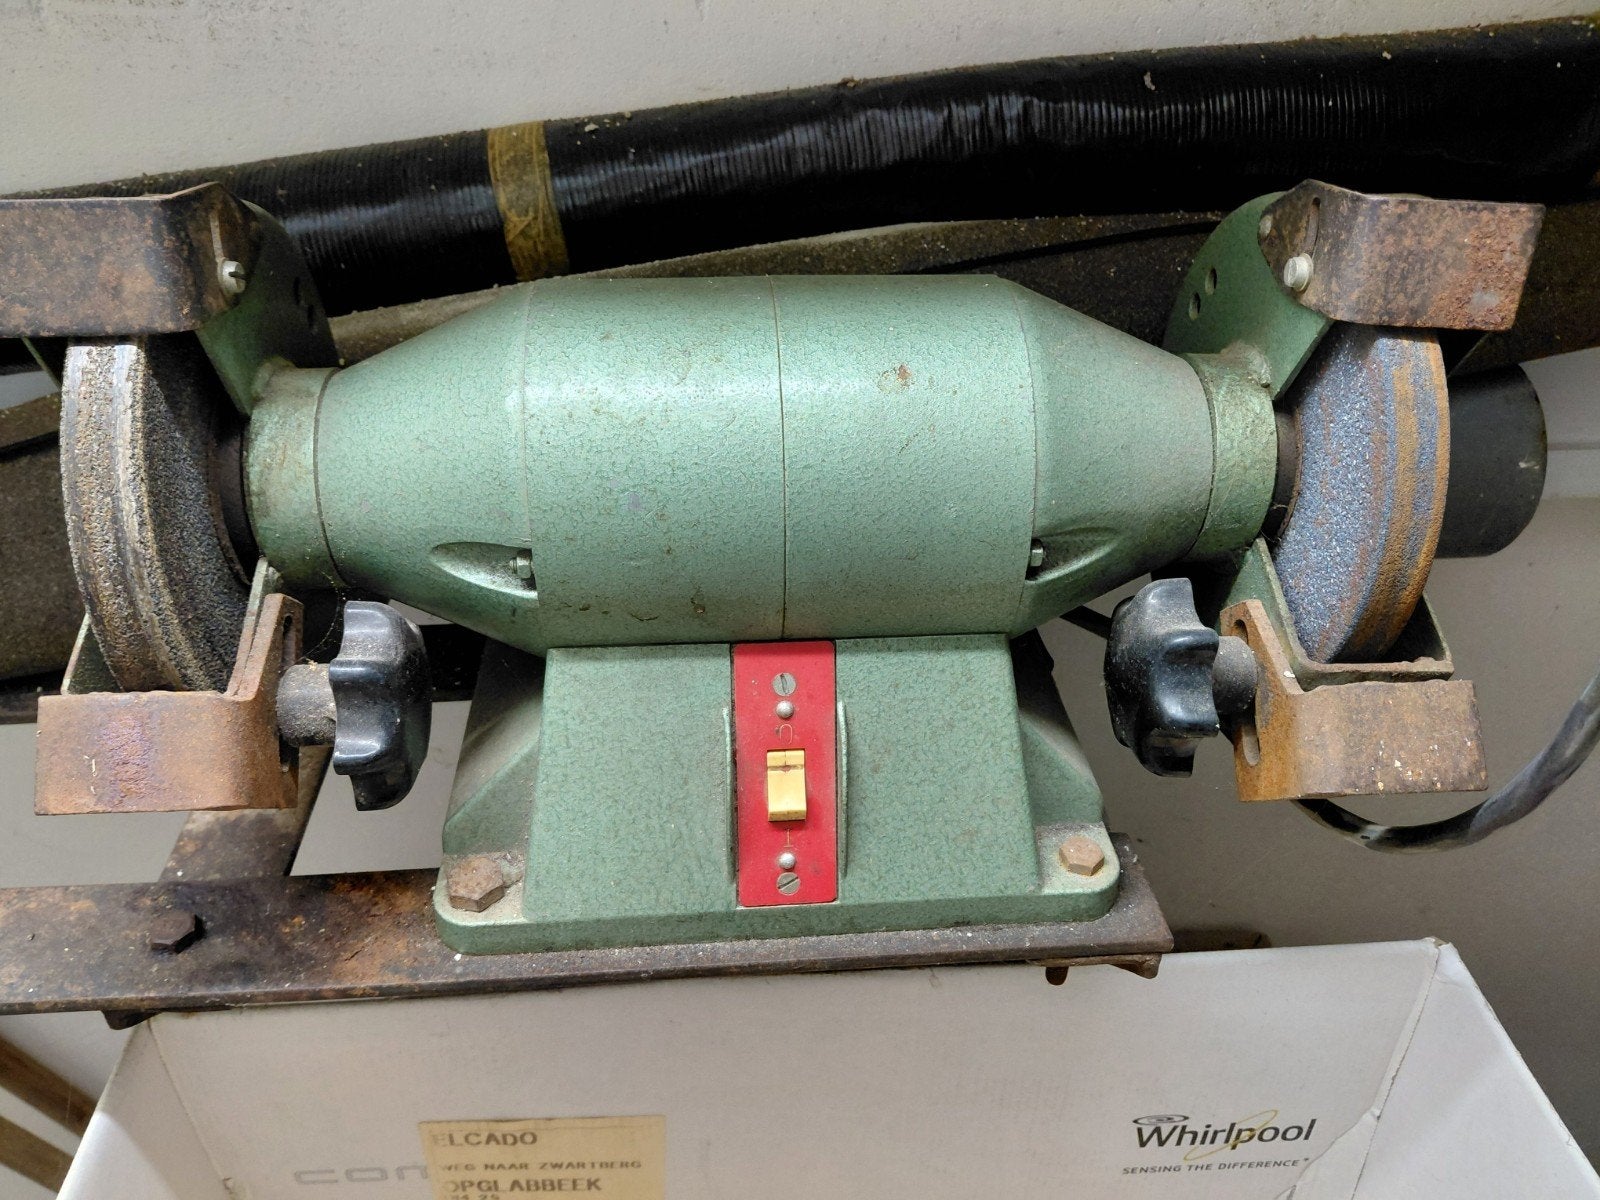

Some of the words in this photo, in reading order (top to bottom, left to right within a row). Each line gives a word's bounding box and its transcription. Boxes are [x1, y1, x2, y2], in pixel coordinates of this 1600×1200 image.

[1136, 1118, 1318, 1150] Whirlpool
[484, 1162, 529, 1171] NAAR
[539, 1160, 642, 1171] ZWARTBERG
[1122, 1165, 1182, 1175] SENSING
[1187, 1163, 1213, 1172] THE
[1218, 1159, 1300, 1170] DIFFERENCE
[442, 1177, 602, 1193] OPGLABBEEK
